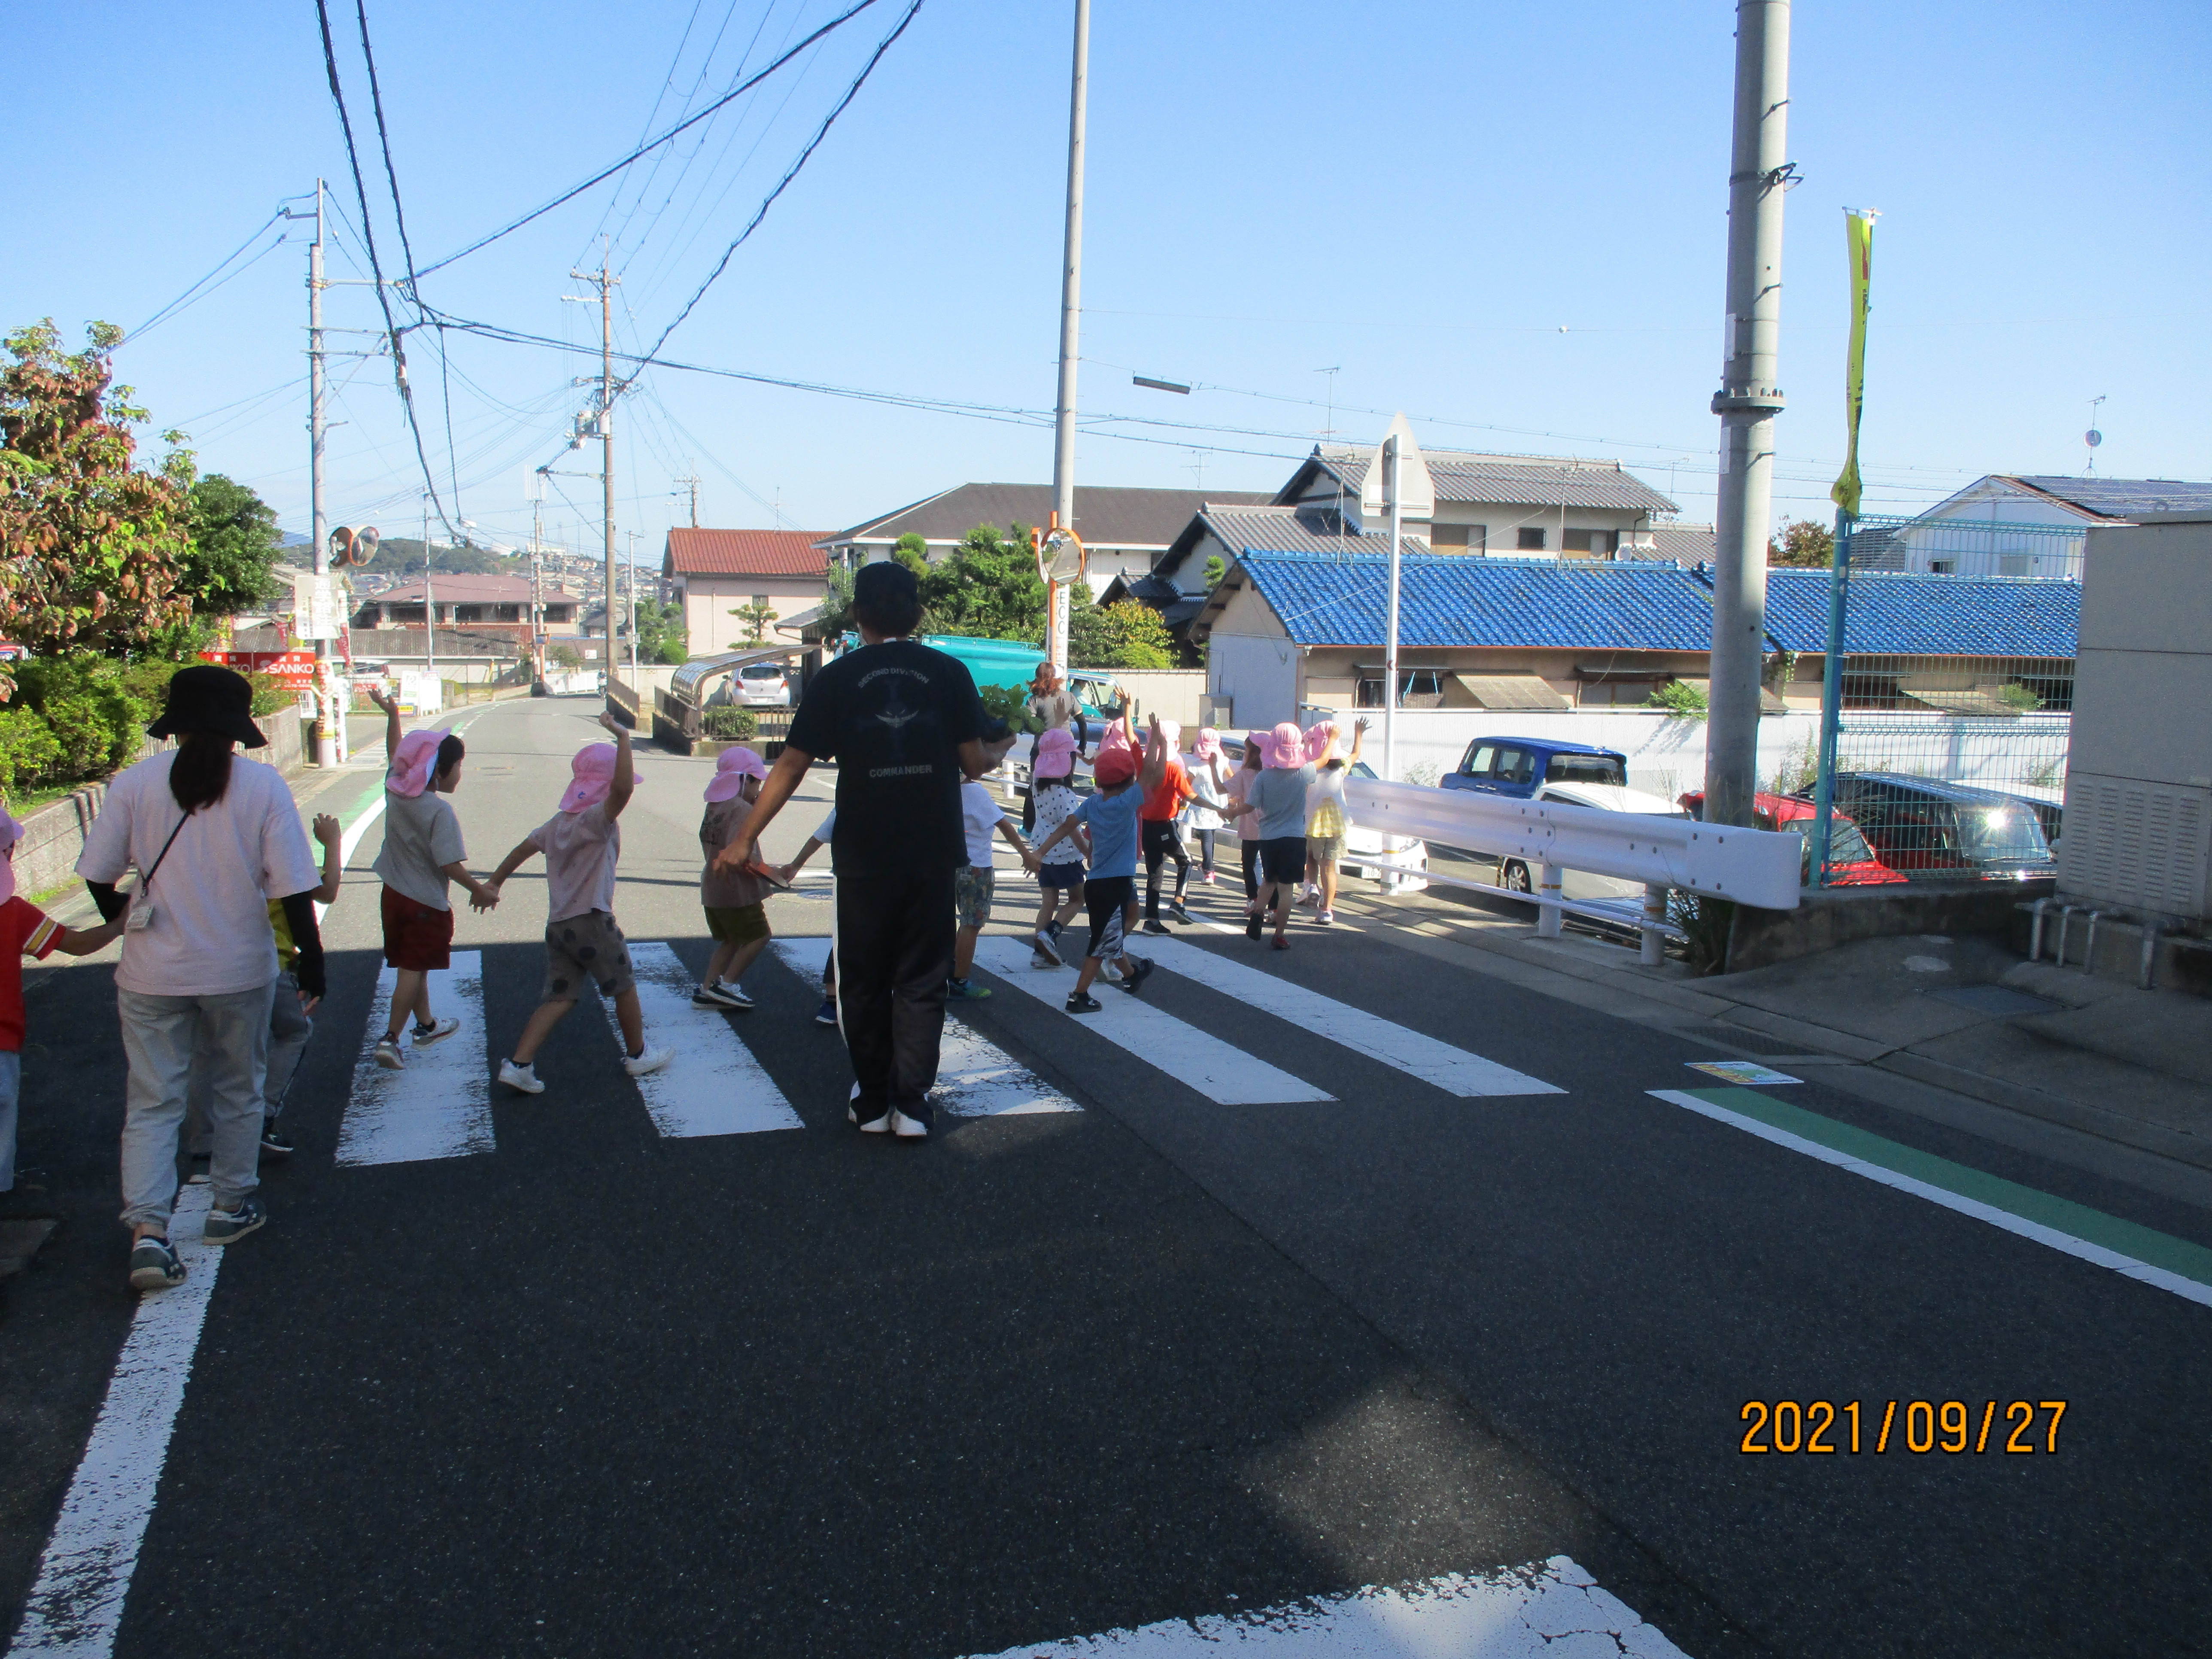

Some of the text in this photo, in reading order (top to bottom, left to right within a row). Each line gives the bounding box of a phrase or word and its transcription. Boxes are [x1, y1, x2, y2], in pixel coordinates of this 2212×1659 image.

[315, 578, 332, 637] 通学路注
[269, 664, 314, 674] SANKO
[858, 668, 889, 688] SECOND
[869, 764, 933, 778] COMMANDER
